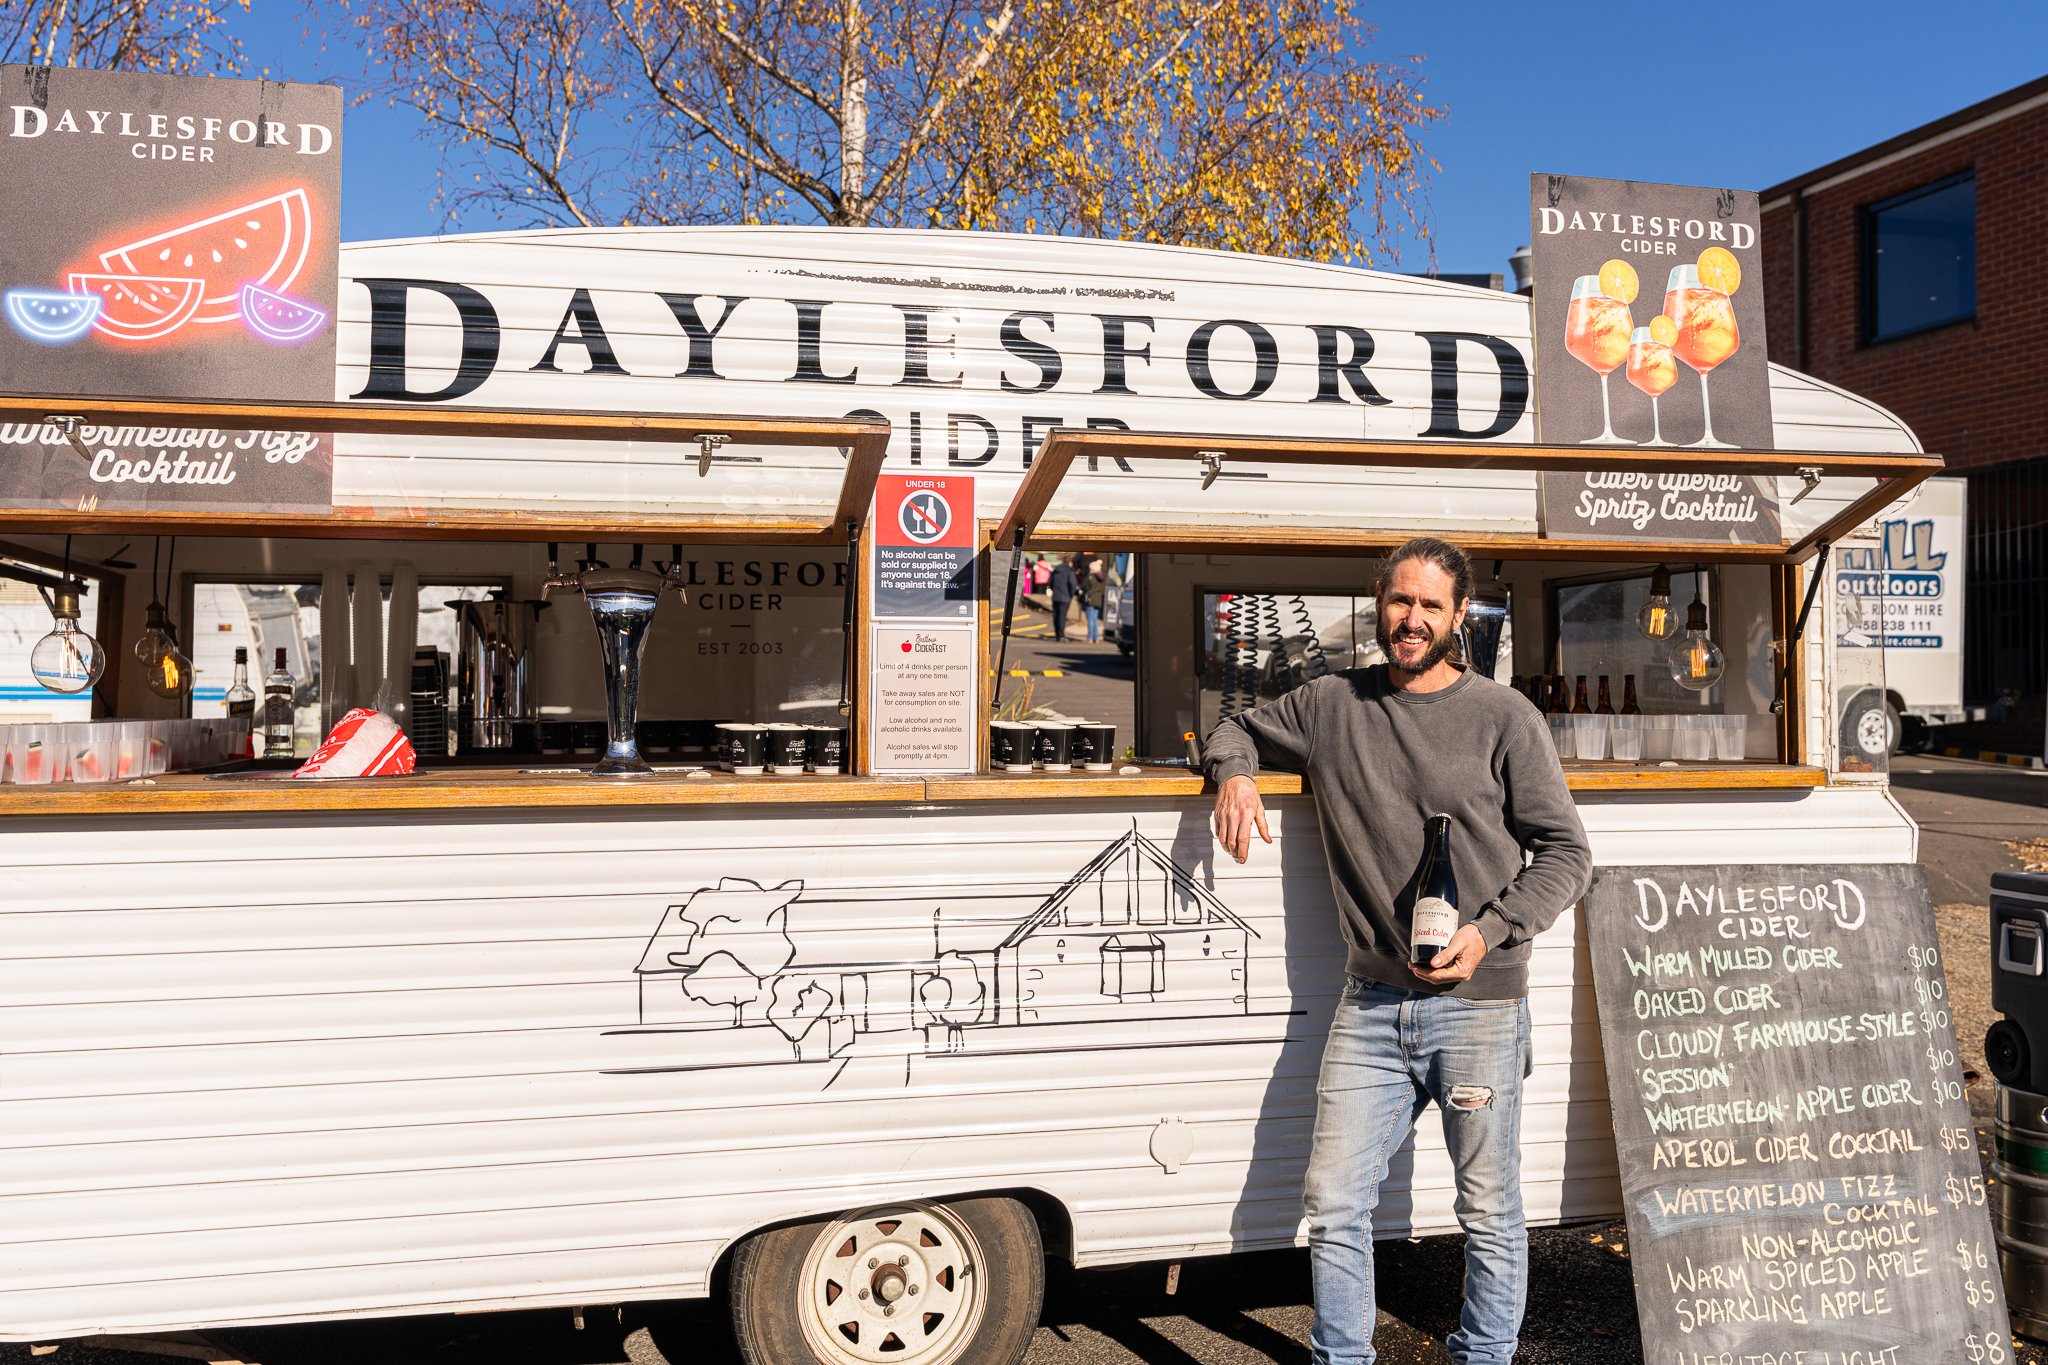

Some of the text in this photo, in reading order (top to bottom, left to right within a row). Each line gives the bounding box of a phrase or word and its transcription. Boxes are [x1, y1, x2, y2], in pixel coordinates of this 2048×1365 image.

[9, 105, 333, 155] DAYLESFORD
[131, 142, 214, 162] CIDER
[1538, 207, 1755, 249] DAYLESFORD
[1620, 238, 1677, 255] CIDER
[349, 277, 1529, 438] DAYLESFORD
[0, 422, 227, 449] Waermelon
[89, 449, 236, 485] Cocktail
[905, 480, 935, 488] UNDER
[1574, 490, 1758, 531] Spritz Cocktail
[881, 551, 956, 560] No alcohol can be
[881, 560, 900, 569] sold
[912, 561, 947, 572] supplied
[575, 559, 849, 594] YLESFOR
[881, 571, 952, 580] anyone under 18.
[881, 580, 959, 590] It's against the law.
[1837, 573, 1939, 596] outdoors
[698, 593, 783, 611] CIDER
[1872, 604, 1909, 616] ROOM
[1915, 604, 1943, 616] HIRE
[1883, 620, 1905, 631] 238
[1911, 621, 1931, 631] 111
[698, 642, 784, 656] EST 2003
[933, 672, 949, 680] time.
[895, 699, 937, 707] consumption
[899, 691, 917, 699] away
[894, 752, 923, 760] promptly
[943, 744, 958, 752] stop
[1633, 877, 1866, 932] DAYLESFORD
[1718, 914, 1811, 940] CIDER
[1621, 944, 1938, 977] WARM MULLED CIDER $10
[1633, 974, 1943, 1020] OAKED CIDER $10
[1920, 1007, 1948, 1039] $10
[1926, 1042, 1954, 1073] $10
[1861, 1078, 1923, 1109] CIDER
[1931, 1076, 1962, 1109] $10
[1653, 1123, 1970, 1171] APEROL CIDER COCKTAIL $15
[1654, 1172, 1987, 1217] WATERMELON FIZZ $15
[1823, 1193, 1939, 1225] COCKTAIL
[1741, 1221, 1920, 1263] NON-ALCOHOLIC
[1667, 1238, 1988, 1296] WARM SPICED APPLE $6
[1675, 1276, 1995, 1334] SPARKLING APPLE $5
[1965, 1331, 2005, 1365] $8
